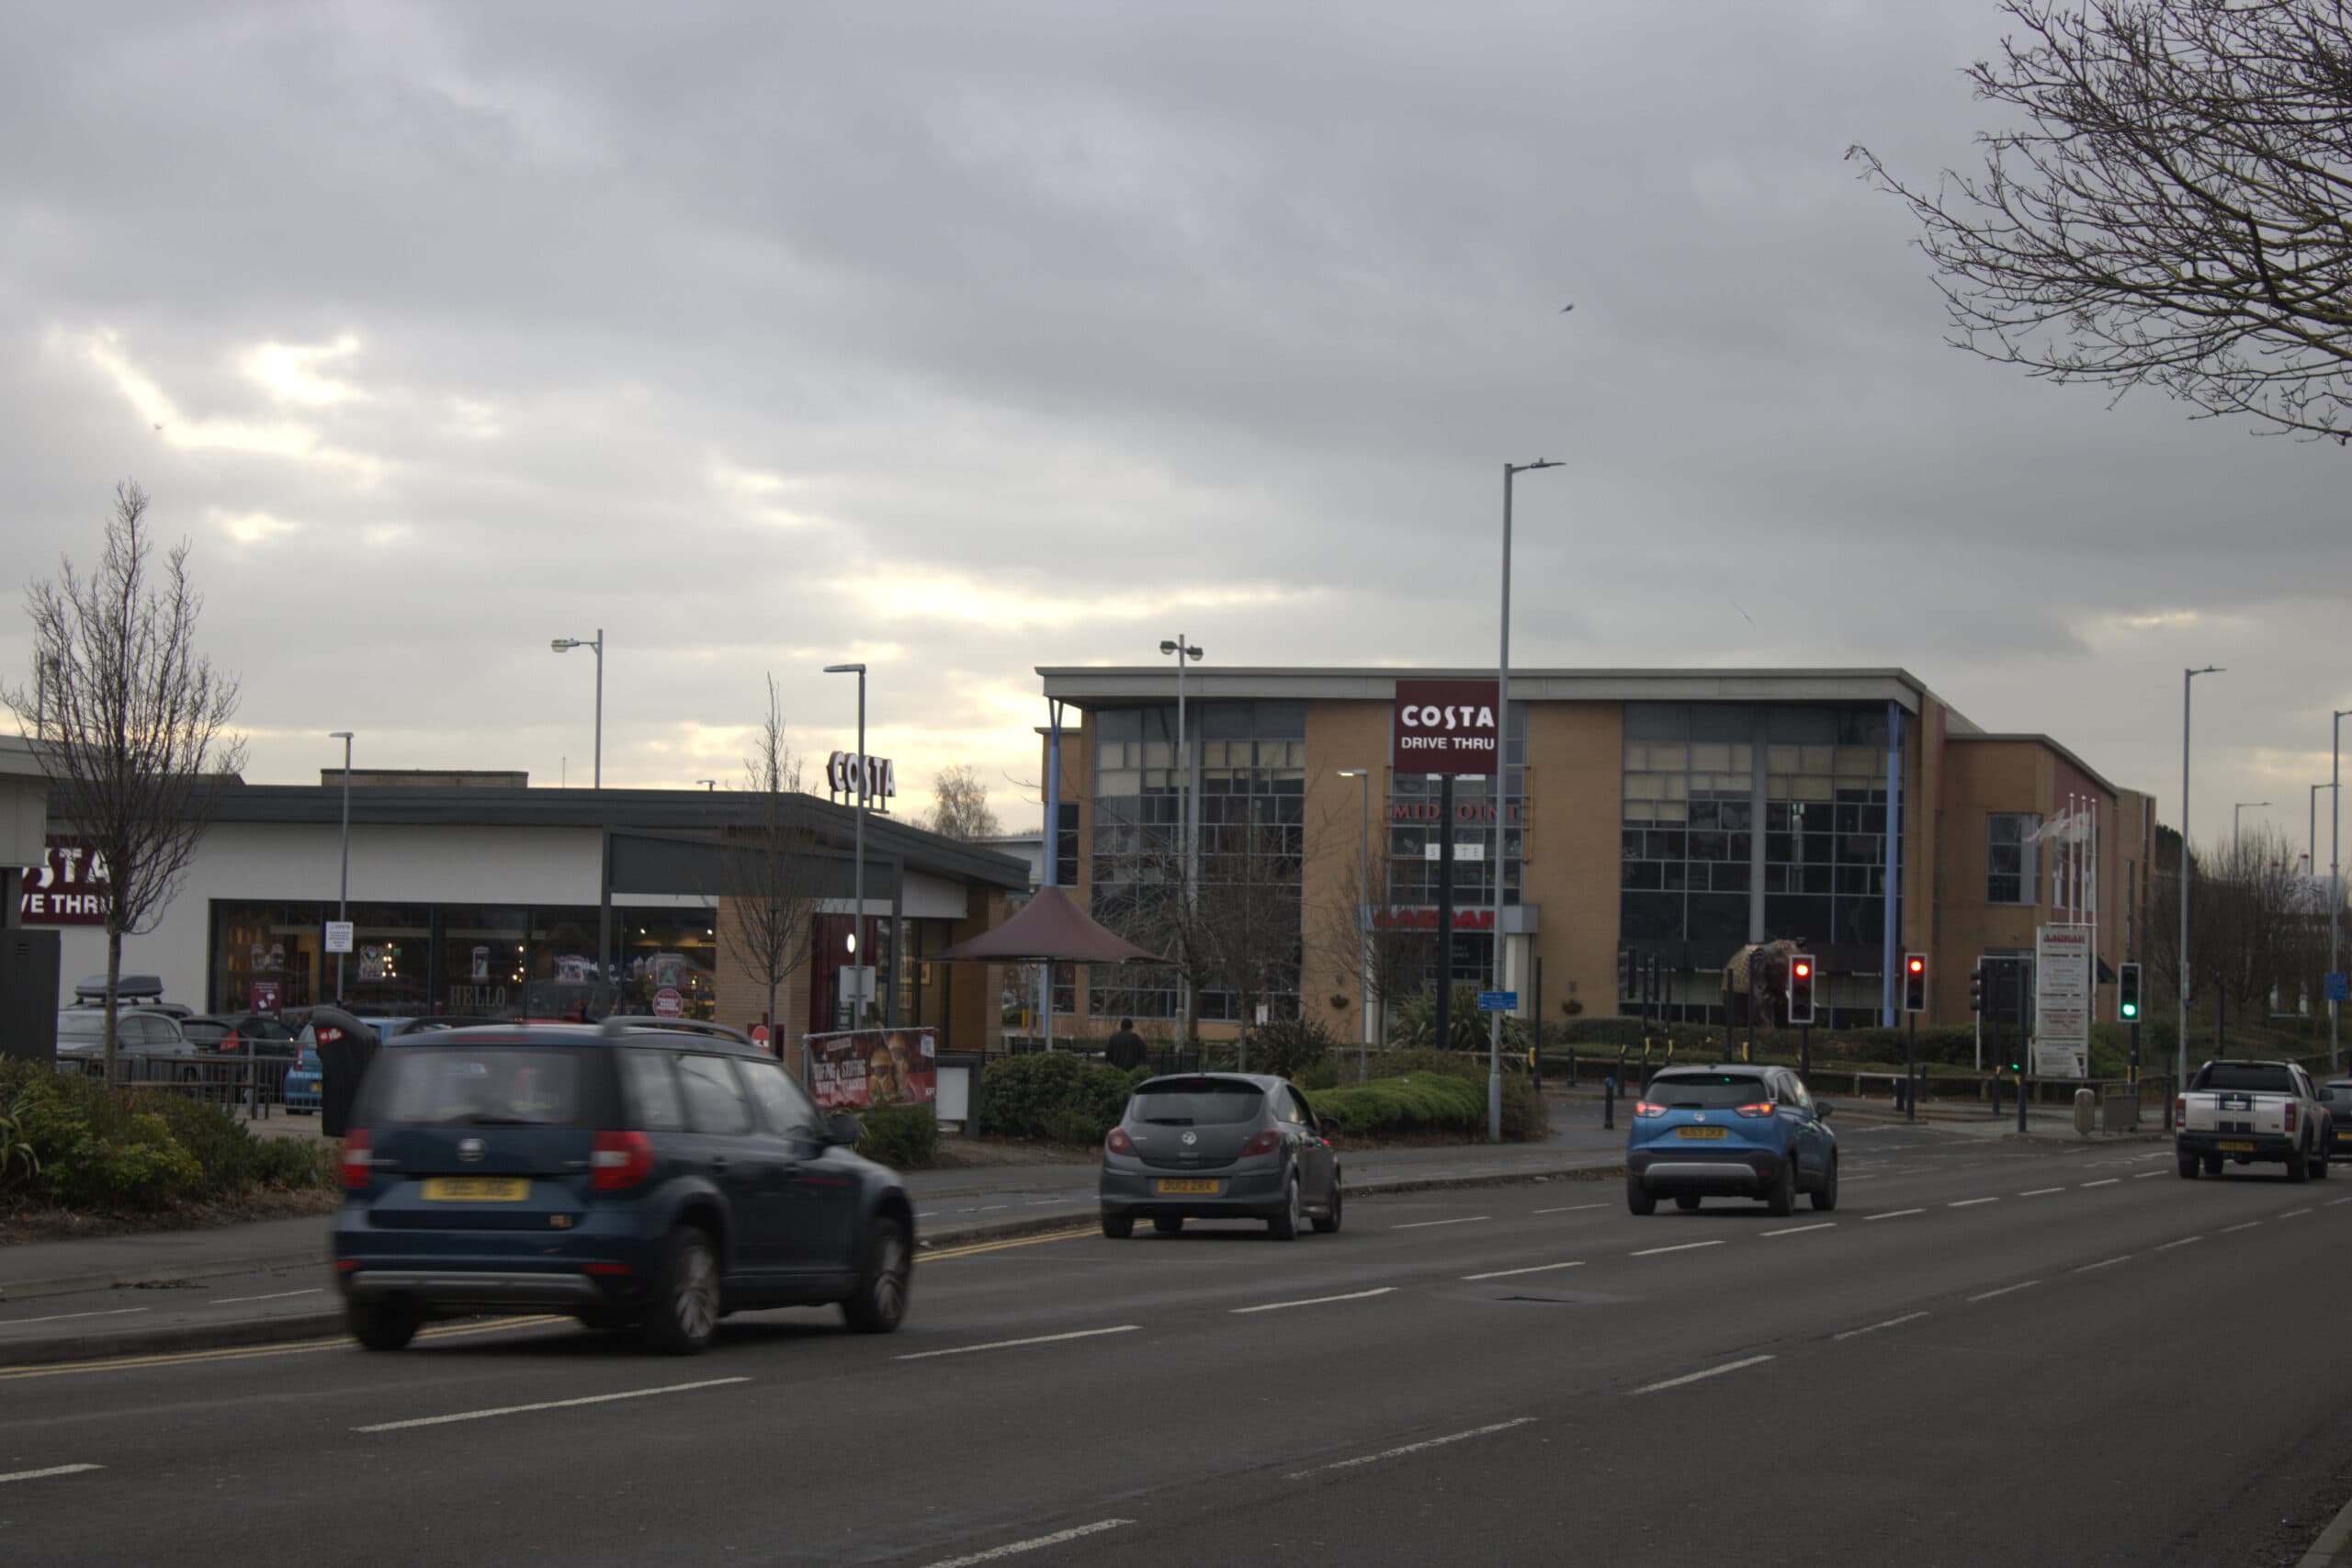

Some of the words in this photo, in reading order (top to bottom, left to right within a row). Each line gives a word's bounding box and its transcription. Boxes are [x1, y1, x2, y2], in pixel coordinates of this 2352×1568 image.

[1401, 705, 1496, 730] COSTA
[1401, 737, 1448, 750] DRIVE
[1453, 737, 1495, 750] THRU
[829, 751, 897, 801] COSTA
[1393, 802, 1521, 820] MIDOINT
[1430, 847, 1479, 858] STE
[22, 847, 111, 889] STA
[51, 894, 114, 915] THRU
[449, 985, 507, 1007] HELLO
